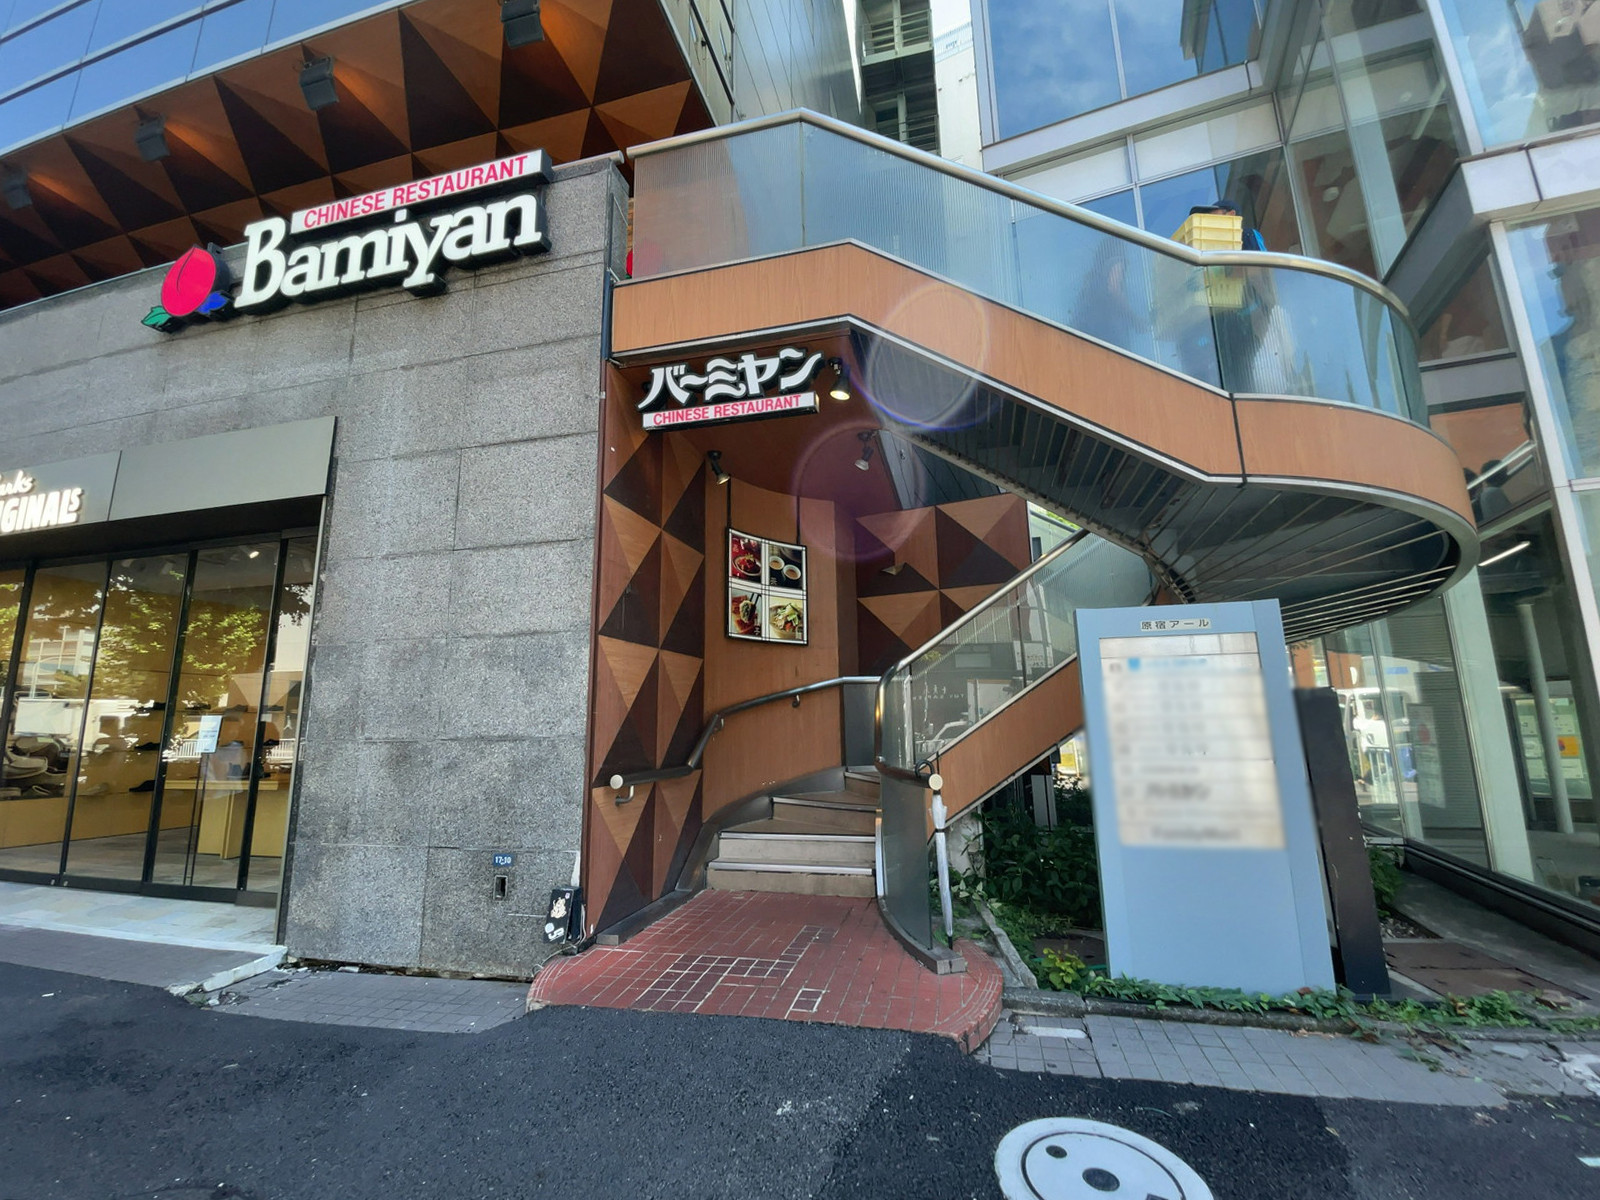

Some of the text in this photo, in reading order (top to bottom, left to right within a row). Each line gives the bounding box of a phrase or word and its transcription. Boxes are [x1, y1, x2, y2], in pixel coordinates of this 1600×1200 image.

[303, 155, 529, 229] CHINESE RESTAURANT
[234, 193, 542, 308] Bamiyan
[637, 348, 822, 409] バーミヤン
[653, 394, 801, 426] CHINESE RESTAURANT
[1141, 619, 1209, 630] 原宿アール
